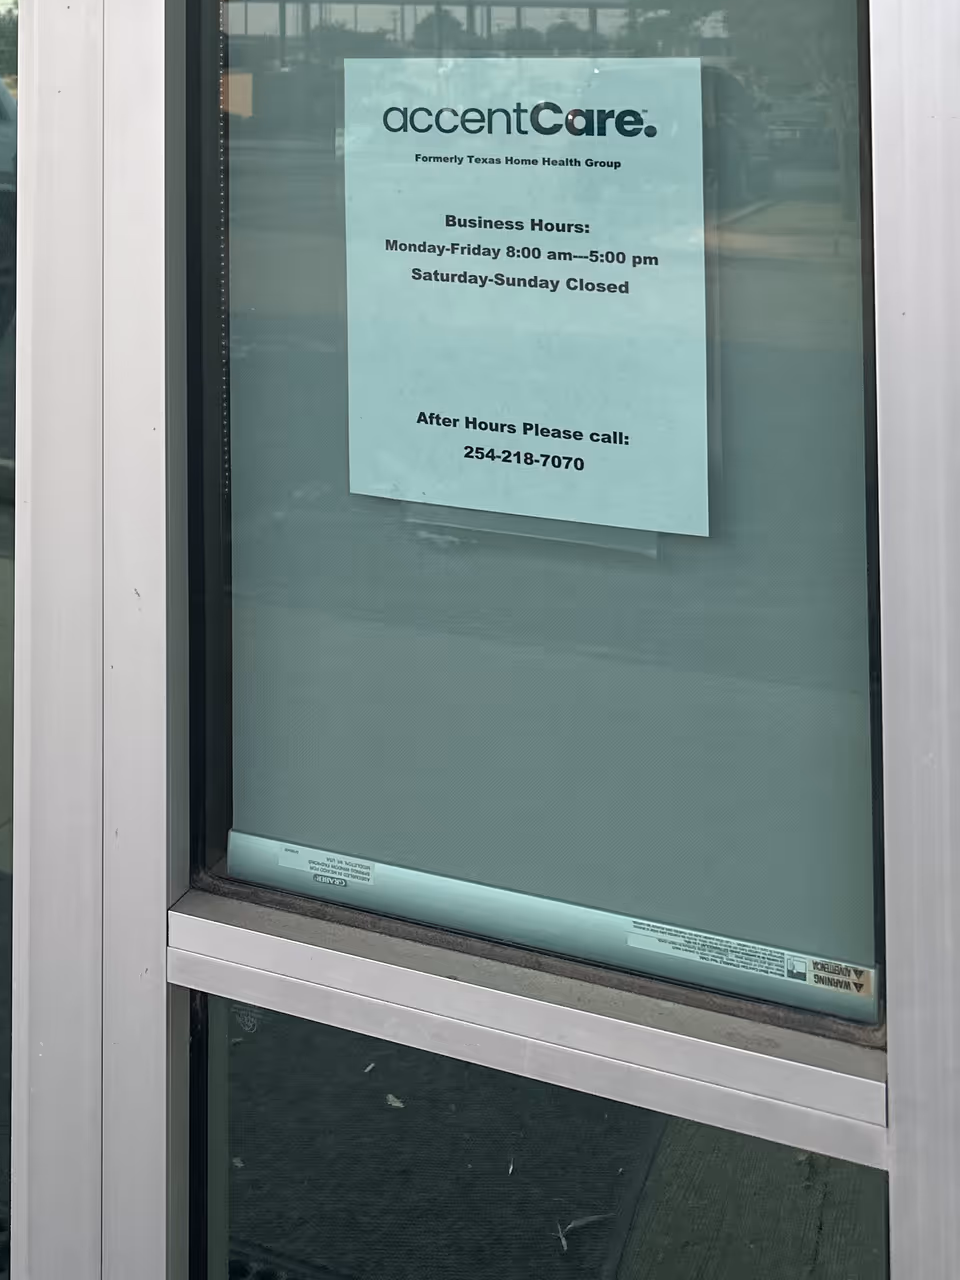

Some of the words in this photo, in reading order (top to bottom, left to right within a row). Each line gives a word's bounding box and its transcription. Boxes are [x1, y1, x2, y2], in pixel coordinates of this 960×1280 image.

[415, 153, 464, 166] Formerly
[467, 155, 501, 165] Texas
[505, 156, 538, 166] Home
[542, 157, 581, 167] Health
[585, 158, 621, 169] Group
[445, 214, 524, 231] Business
[530, 219, 590, 234] Hours:
[385, 239, 501, 259] Monday-Friday
[506, 245, 542, 259] 8:00
[631, 255, 659, 268] pm
[411, 268, 560, 292] Saturday-Sunday
[565, 277, 630, 294] Closed
[416, 411, 460, 428] After
[464, 416, 517, 434] Hours
[522, 422, 584, 441] Please
[589, 430, 630, 446] call:
[463, 445, 585, 471] 254-218-7070
[813, 974, 852, 991] WARNING
